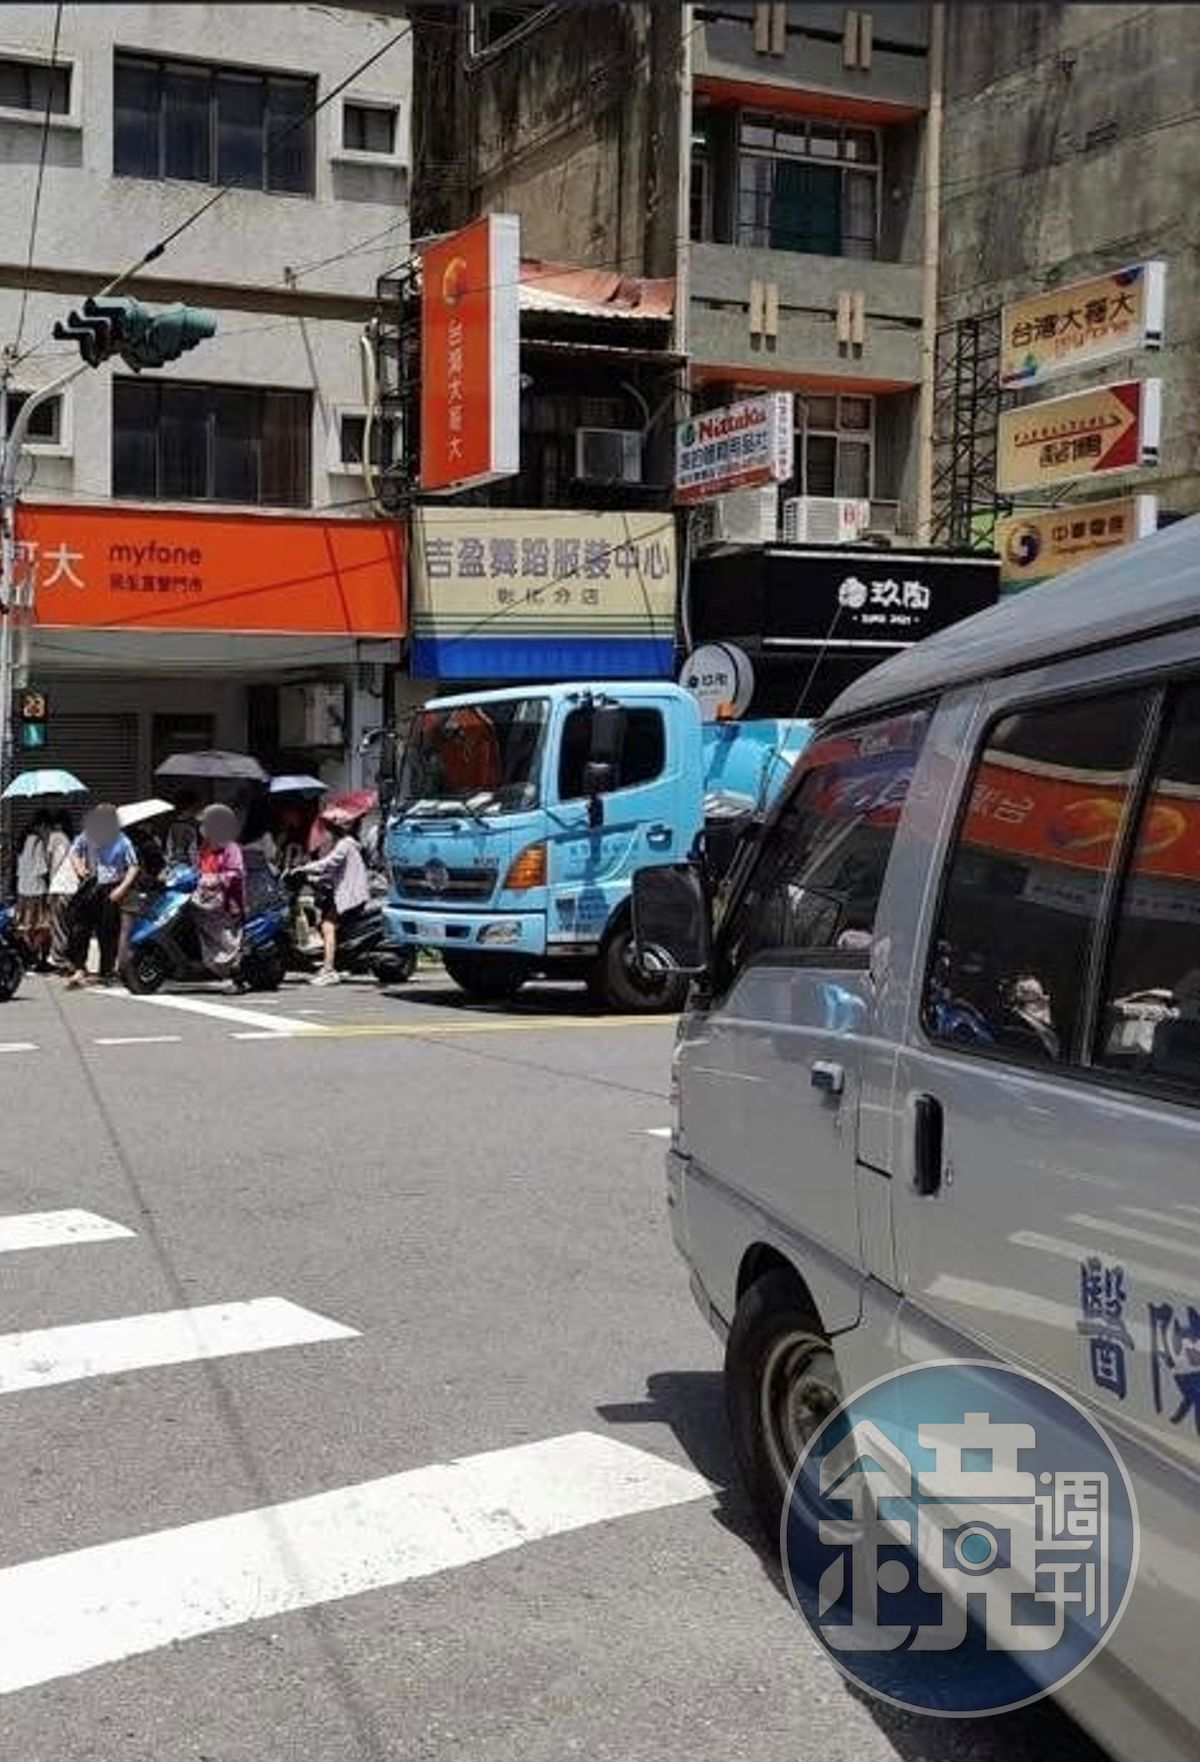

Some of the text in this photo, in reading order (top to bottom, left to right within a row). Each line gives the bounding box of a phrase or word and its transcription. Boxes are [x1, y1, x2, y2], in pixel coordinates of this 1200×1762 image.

[1010, 291, 1136, 348] 台灣大哥大
[110, 540, 202, 567] myfone
[426, 537, 670, 580] 吉盈舞蹈服裝中心
